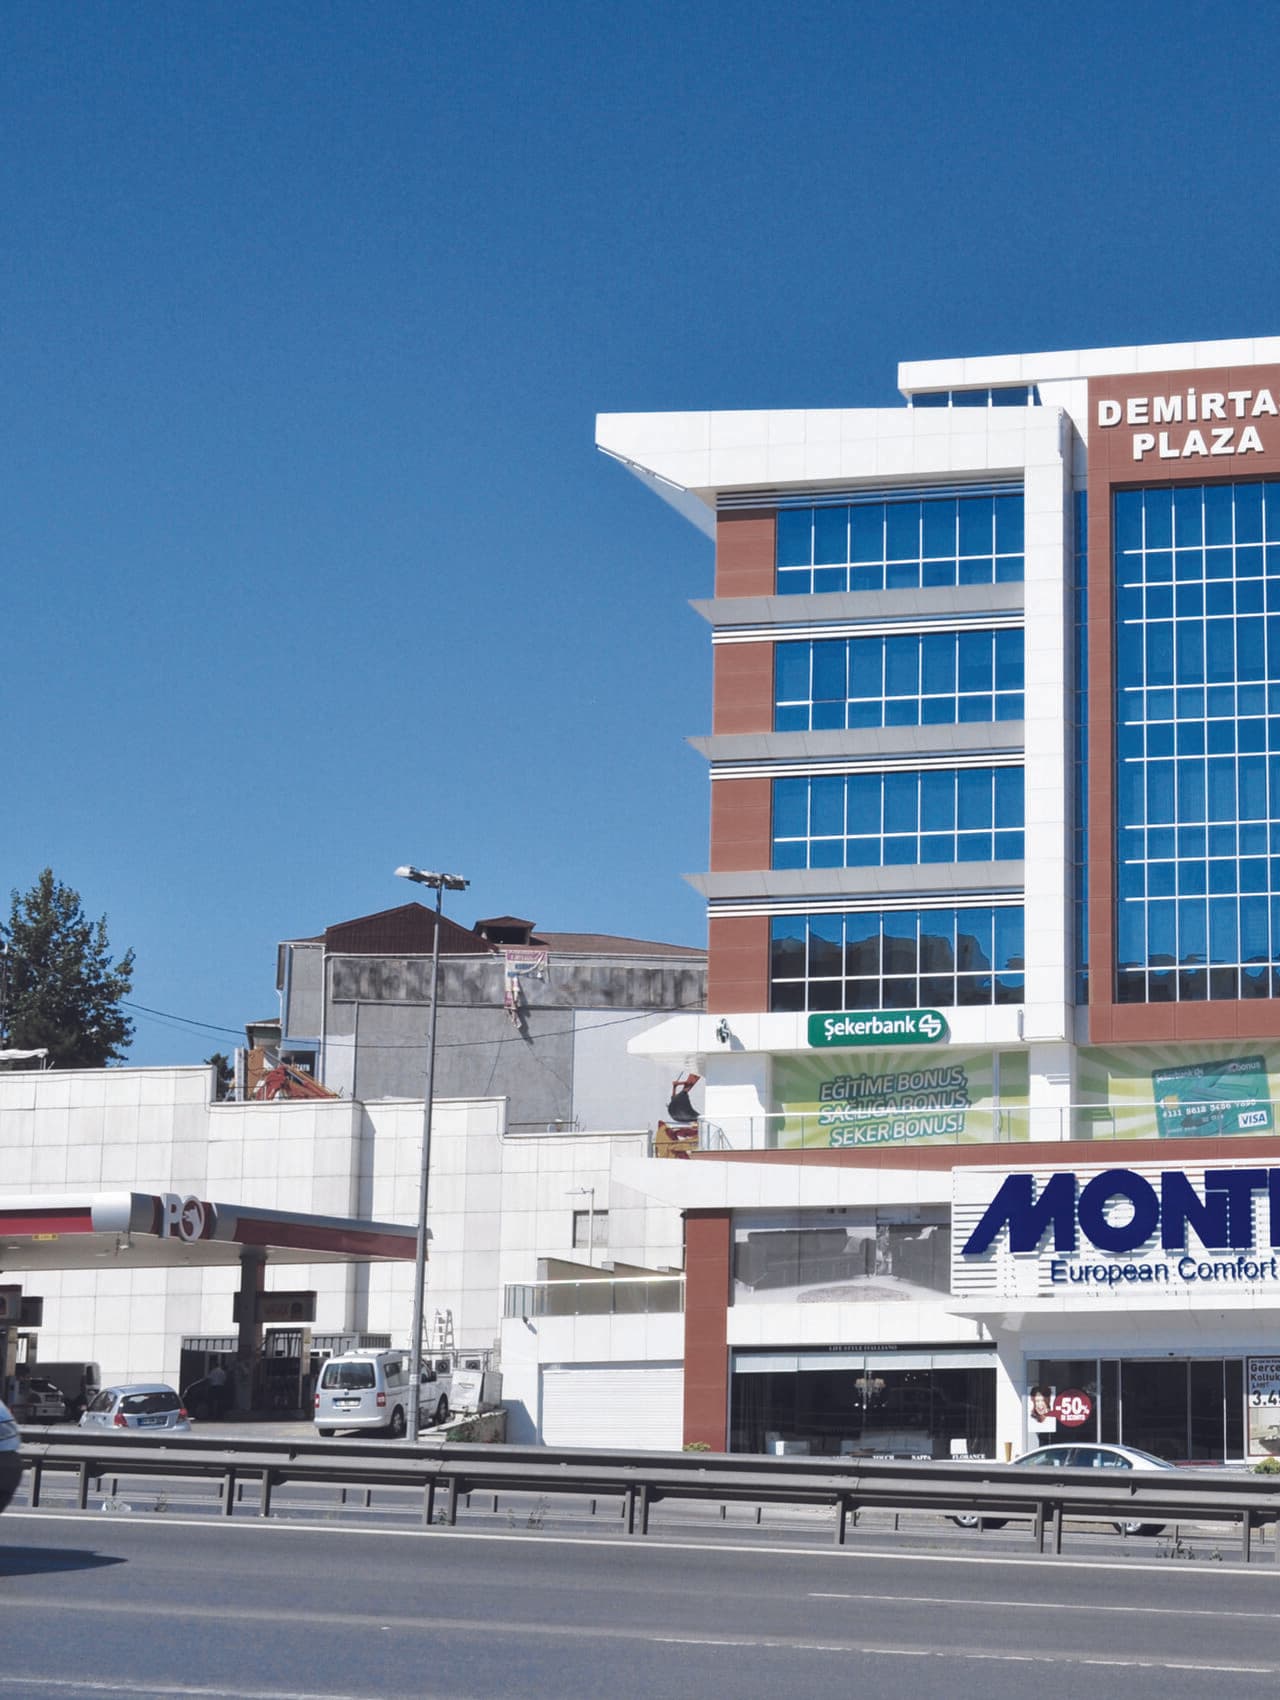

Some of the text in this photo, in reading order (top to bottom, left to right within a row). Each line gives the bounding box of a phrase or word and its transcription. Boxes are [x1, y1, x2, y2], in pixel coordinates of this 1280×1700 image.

[1133, 426, 1265, 461] PLAZA
[824, 1013, 917, 1041] Şekerbank
[820, 1065, 969, 1101] EĞİTİME BONUS,
[901, 1090, 971, 1112] BONUS,
[831, 1115, 964, 1147] ŞEKER BONUS!
[1241, 1112, 1266, 1126] VISA
[1051, 1255, 1278, 1286] European Comfort
[1250, 1373, 1280, 1381] Koltuk
[1055, 1396, 1090, 1415] -50%
